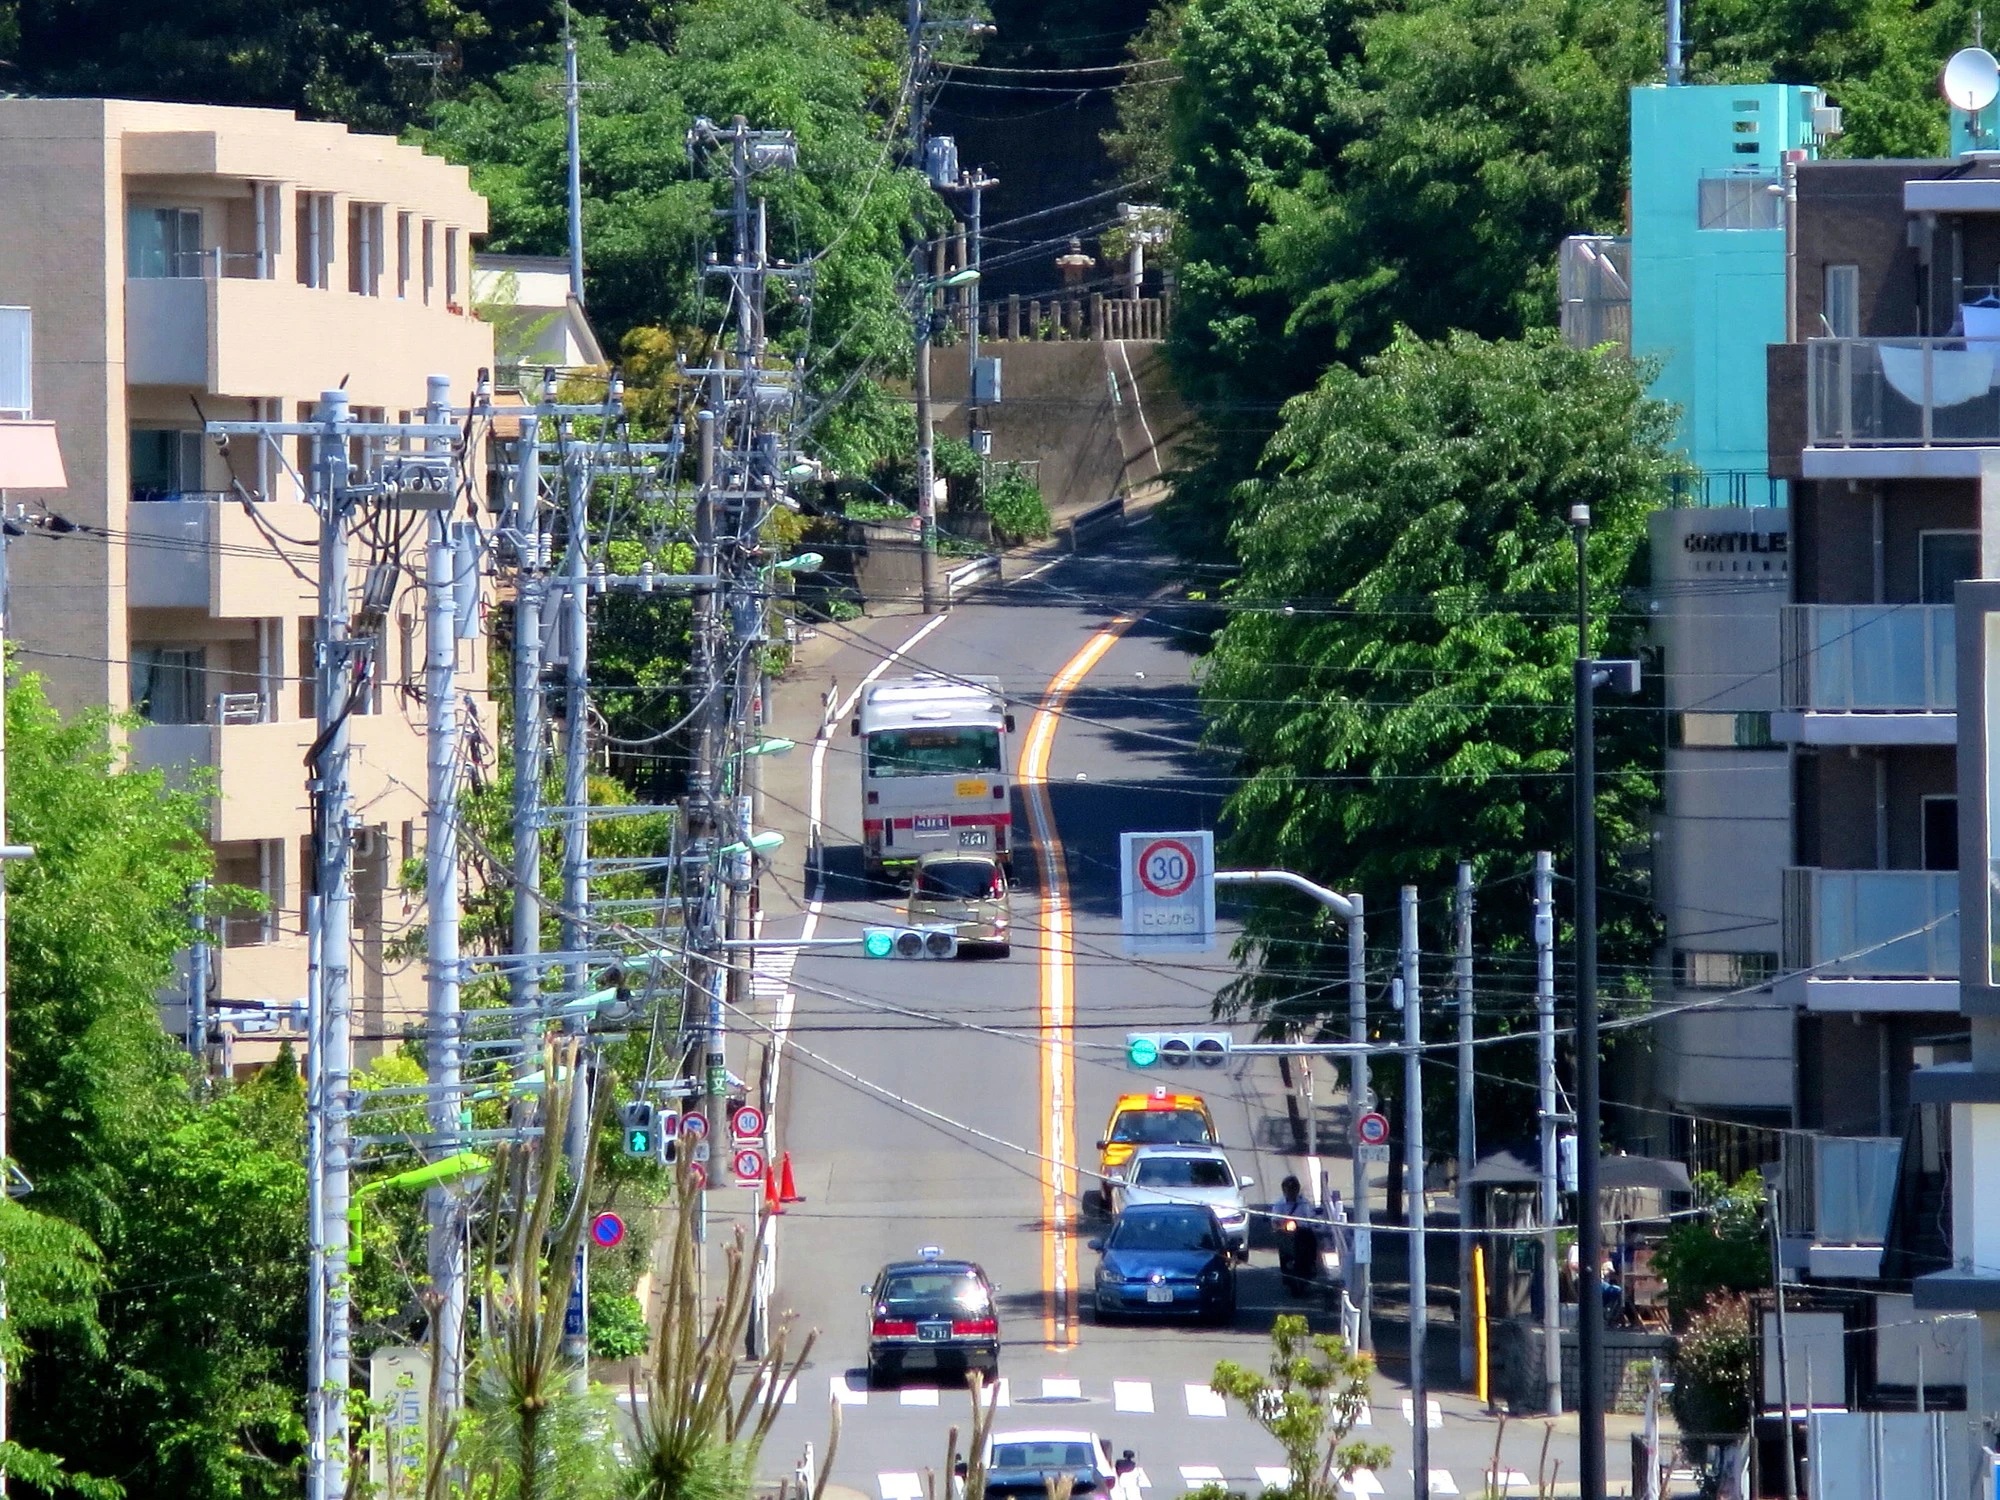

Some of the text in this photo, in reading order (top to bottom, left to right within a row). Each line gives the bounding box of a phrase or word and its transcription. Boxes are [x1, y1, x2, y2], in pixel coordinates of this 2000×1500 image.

[1684, 532, 1787, 552] CORTILE
[1152, 856, 1183, 881] 30
[1142, 913, 1195, 926] ここから
[741, 1115, 757, 1129] 30
